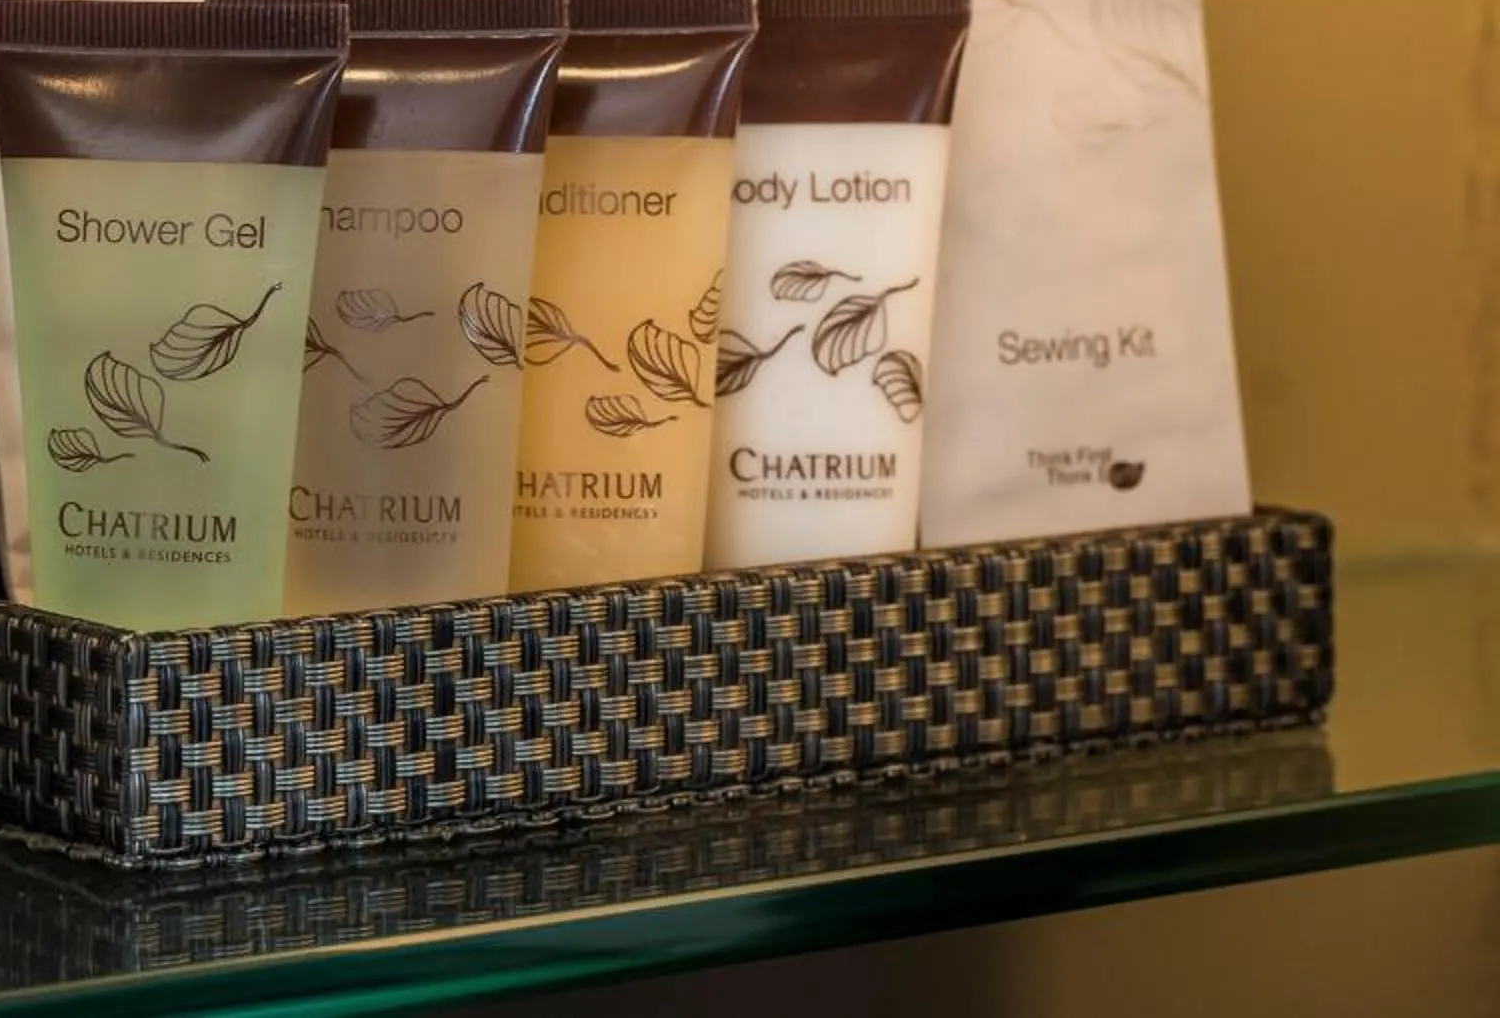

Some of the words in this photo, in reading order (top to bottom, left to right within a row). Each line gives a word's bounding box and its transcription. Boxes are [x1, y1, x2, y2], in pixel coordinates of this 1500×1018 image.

[539, 182, 678, 217] ditioner
[731, 170, 798, 210] ody
[810, 170, 911, 203] Lotion
[56, 208, 196, 246] Shower
[204, 212, 265, 249] Gel
[321, 205, 464, 240] ampoo
[997, 328, 1111, 369] Sewing
[1117, 324, 1157, 358] Kit
[728, 447, 897, 483] CHATRIUM
[516, 470, 663, 500] HATRIUM
[737, 487, 794, 500] HOTELS
[288, 485, 462, 523] CHATRIUM
[512, 504, 548, 519] TELS
[58, 501, 238, 543] CHATRIUM
[64, 543, 117, 560] HOTELS
[137, 547, 232, 564] RESIDENCES
